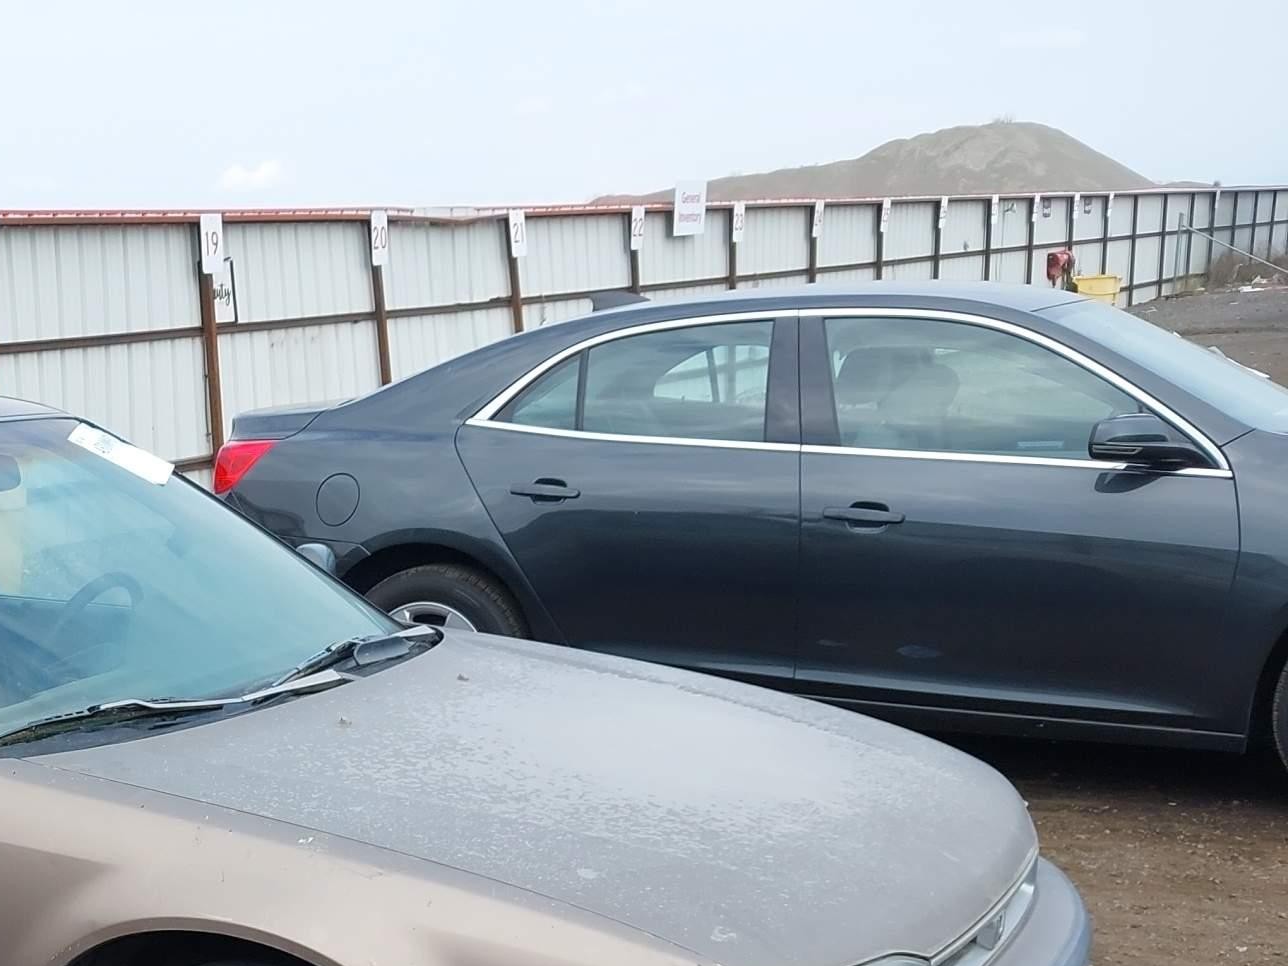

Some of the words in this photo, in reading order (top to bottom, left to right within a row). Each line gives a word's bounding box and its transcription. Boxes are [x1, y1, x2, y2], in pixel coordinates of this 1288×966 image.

[373, 226, 387, 249] 20
[513, 222, 524, 243] 21
[632, 217, 644, 237] 22
[205, 231, 219, 256] 19
